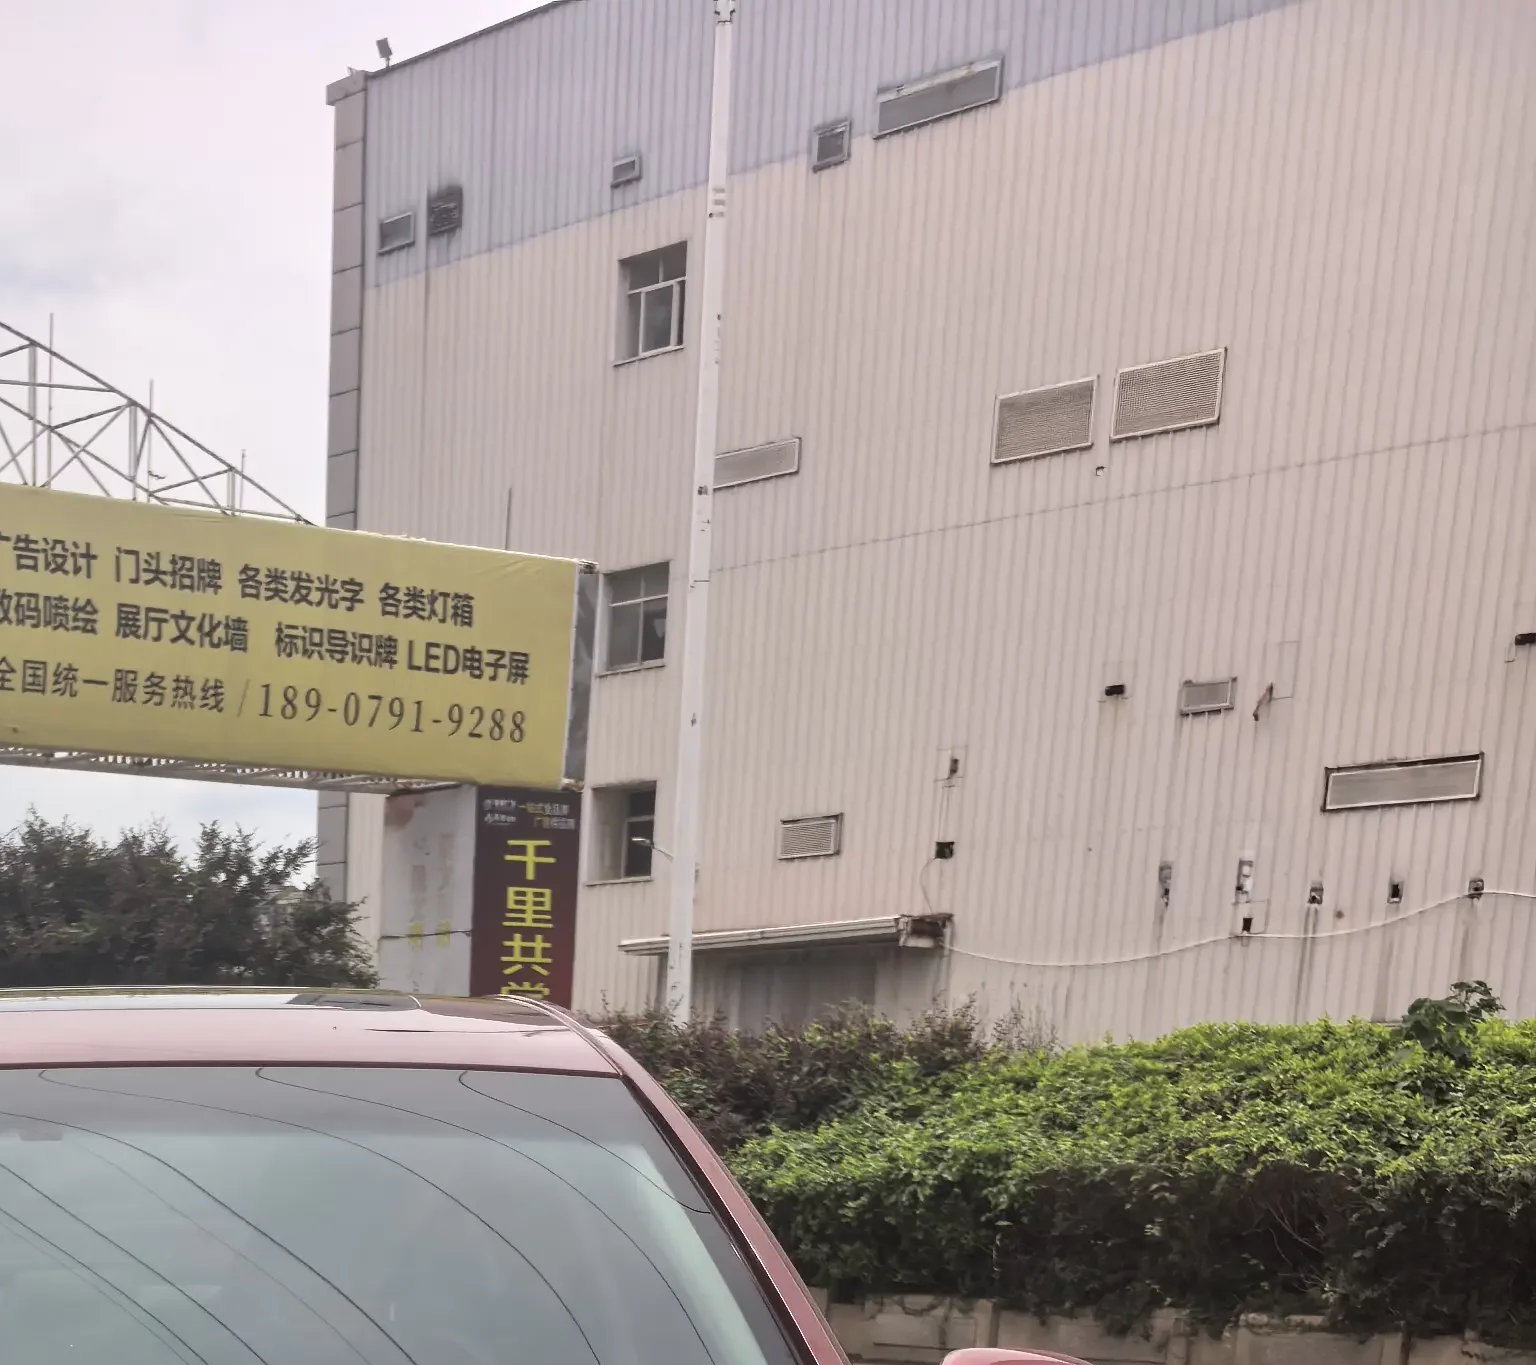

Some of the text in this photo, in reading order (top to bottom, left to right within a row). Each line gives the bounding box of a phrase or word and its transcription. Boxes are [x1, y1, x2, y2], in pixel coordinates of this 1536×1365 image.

[115, 547, 223, 596] 门头招牌
[238, 563, 365, 612] 各类发光字
[378, 582, 475, 628] 各类灯箱
[115, 603, 249, 654] 展厅文化墙
[275, 621, 399, 670] 标识导识牌
[407, 640, 530, 686] LED电子屏
[259, 683, 526, 743] 189-0791-9288
